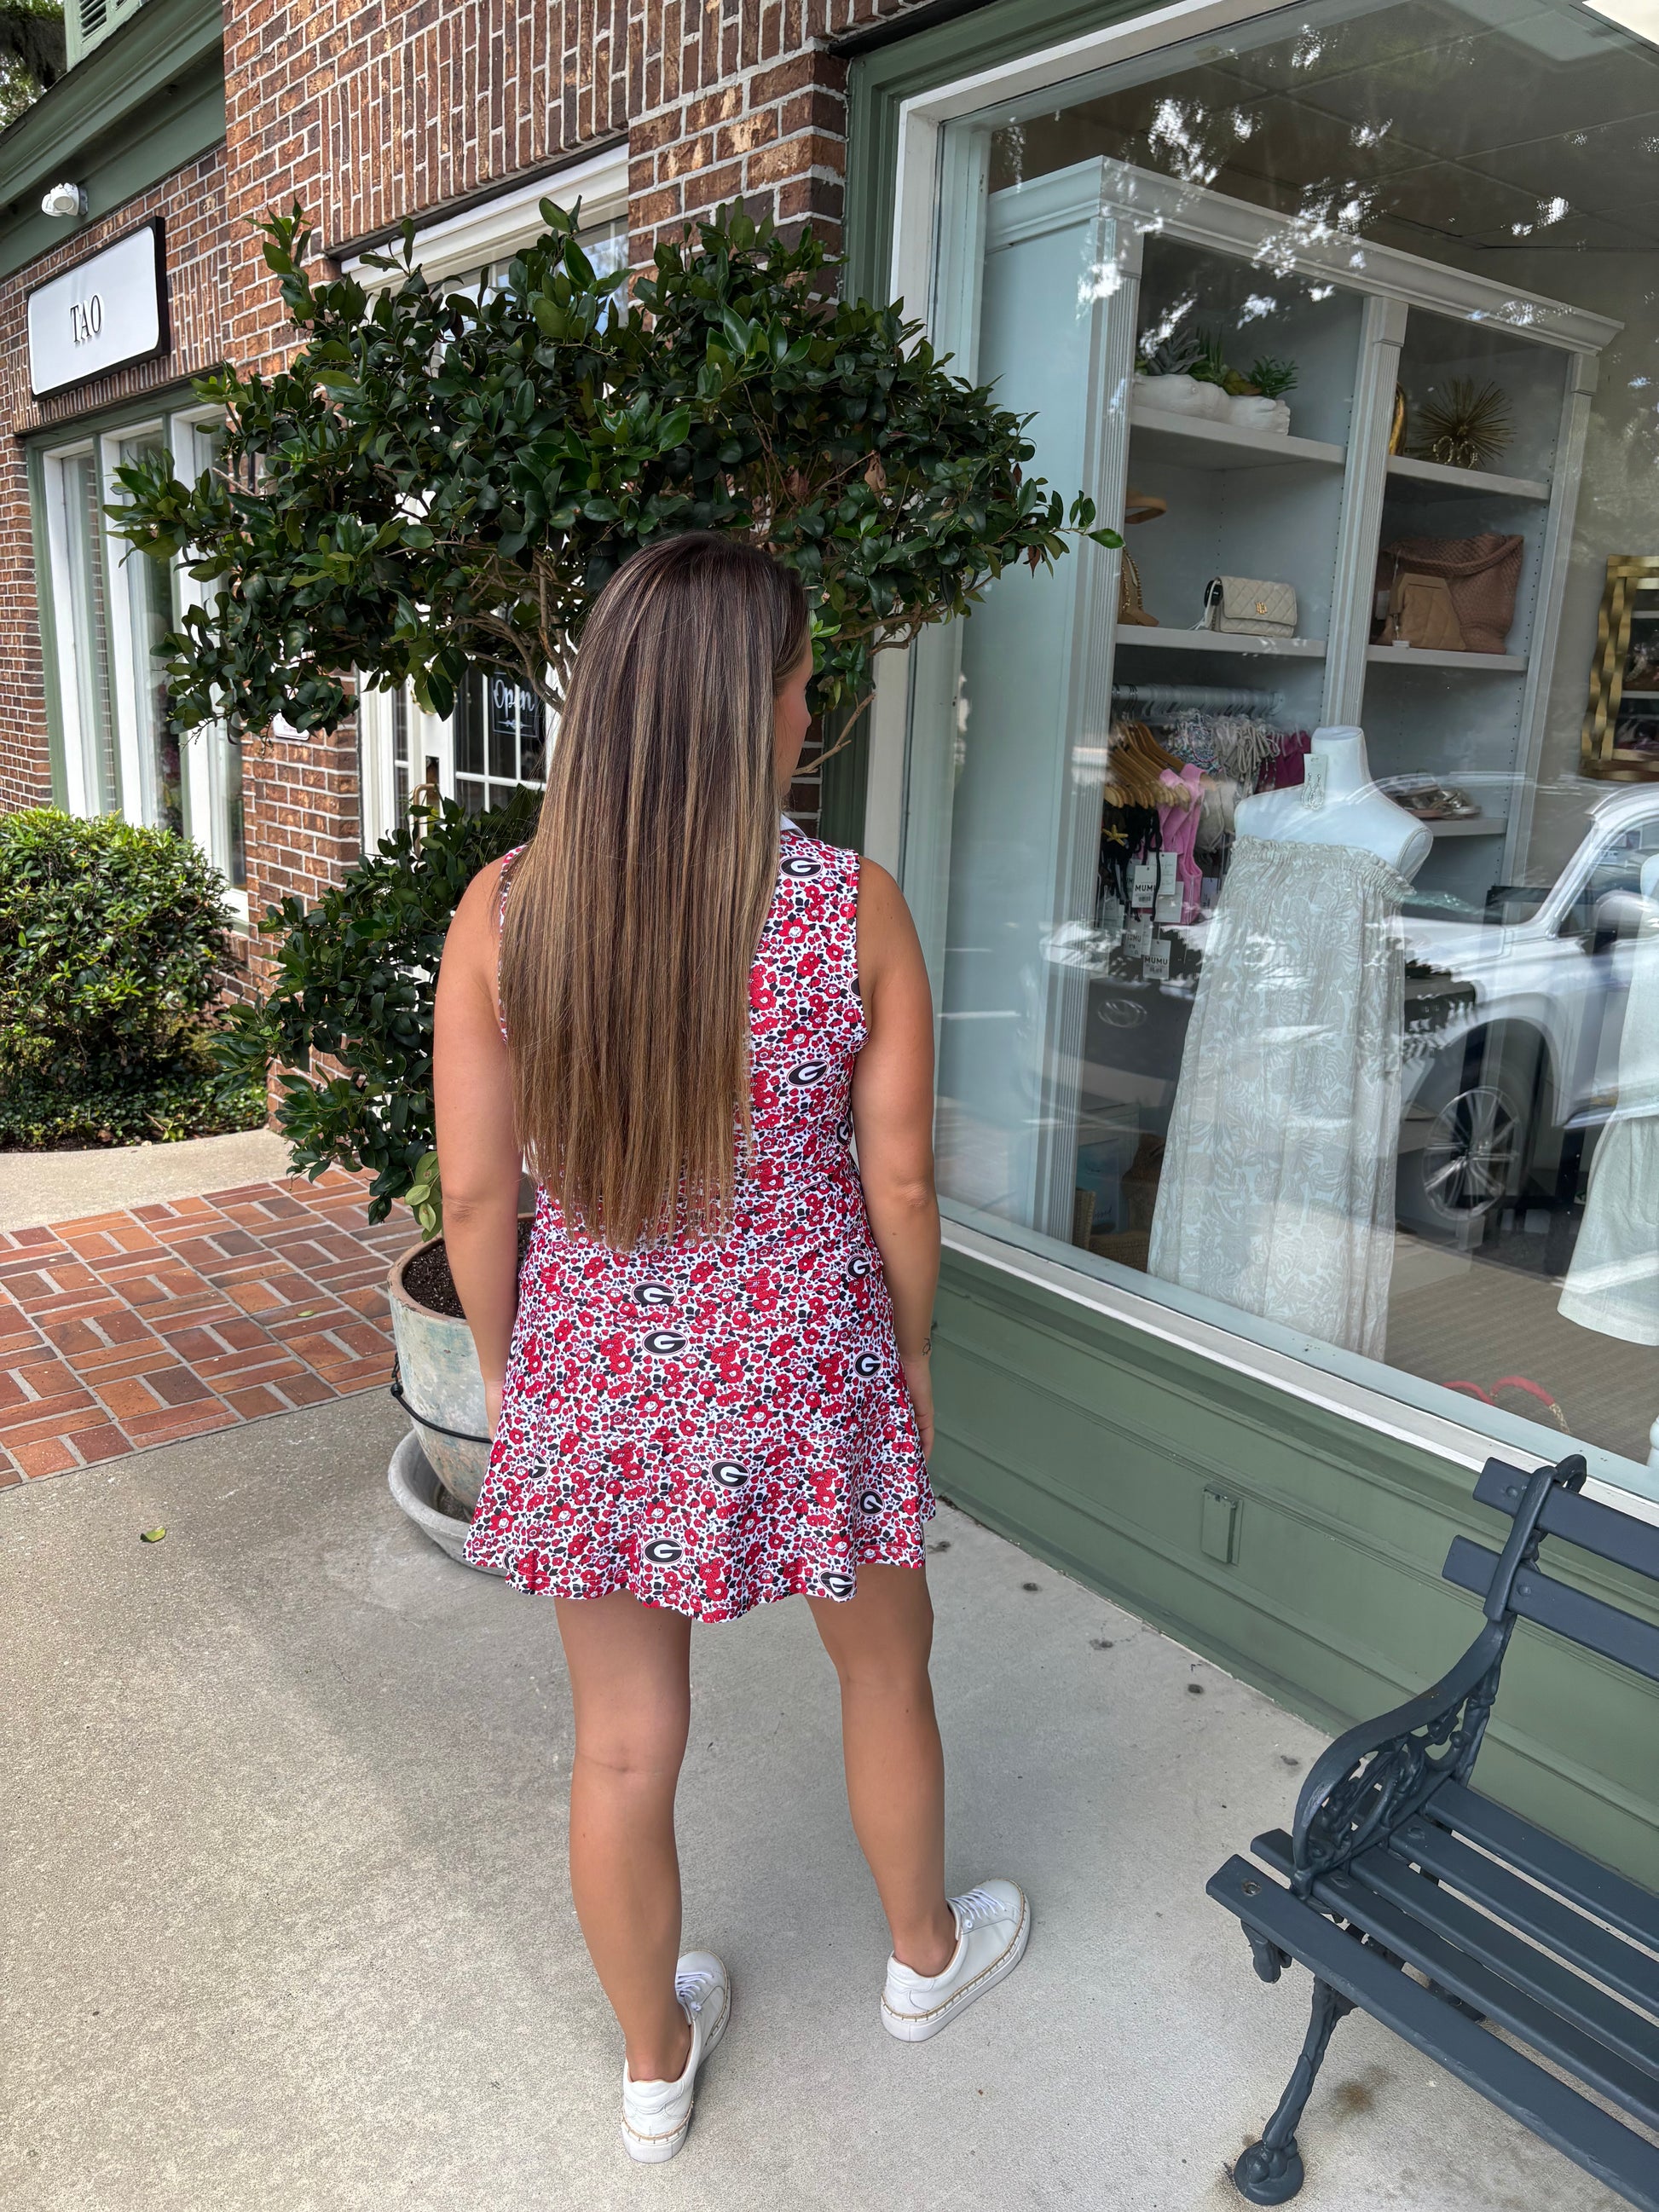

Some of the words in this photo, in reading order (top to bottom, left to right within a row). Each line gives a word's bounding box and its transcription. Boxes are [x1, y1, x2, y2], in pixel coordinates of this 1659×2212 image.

[70, 295, 101, 343] TAO
[494, 679, 535, 718] Opn
[1135, 884, 1156, 892] MUM
[1144, 956, 1168, 966] MUMU
